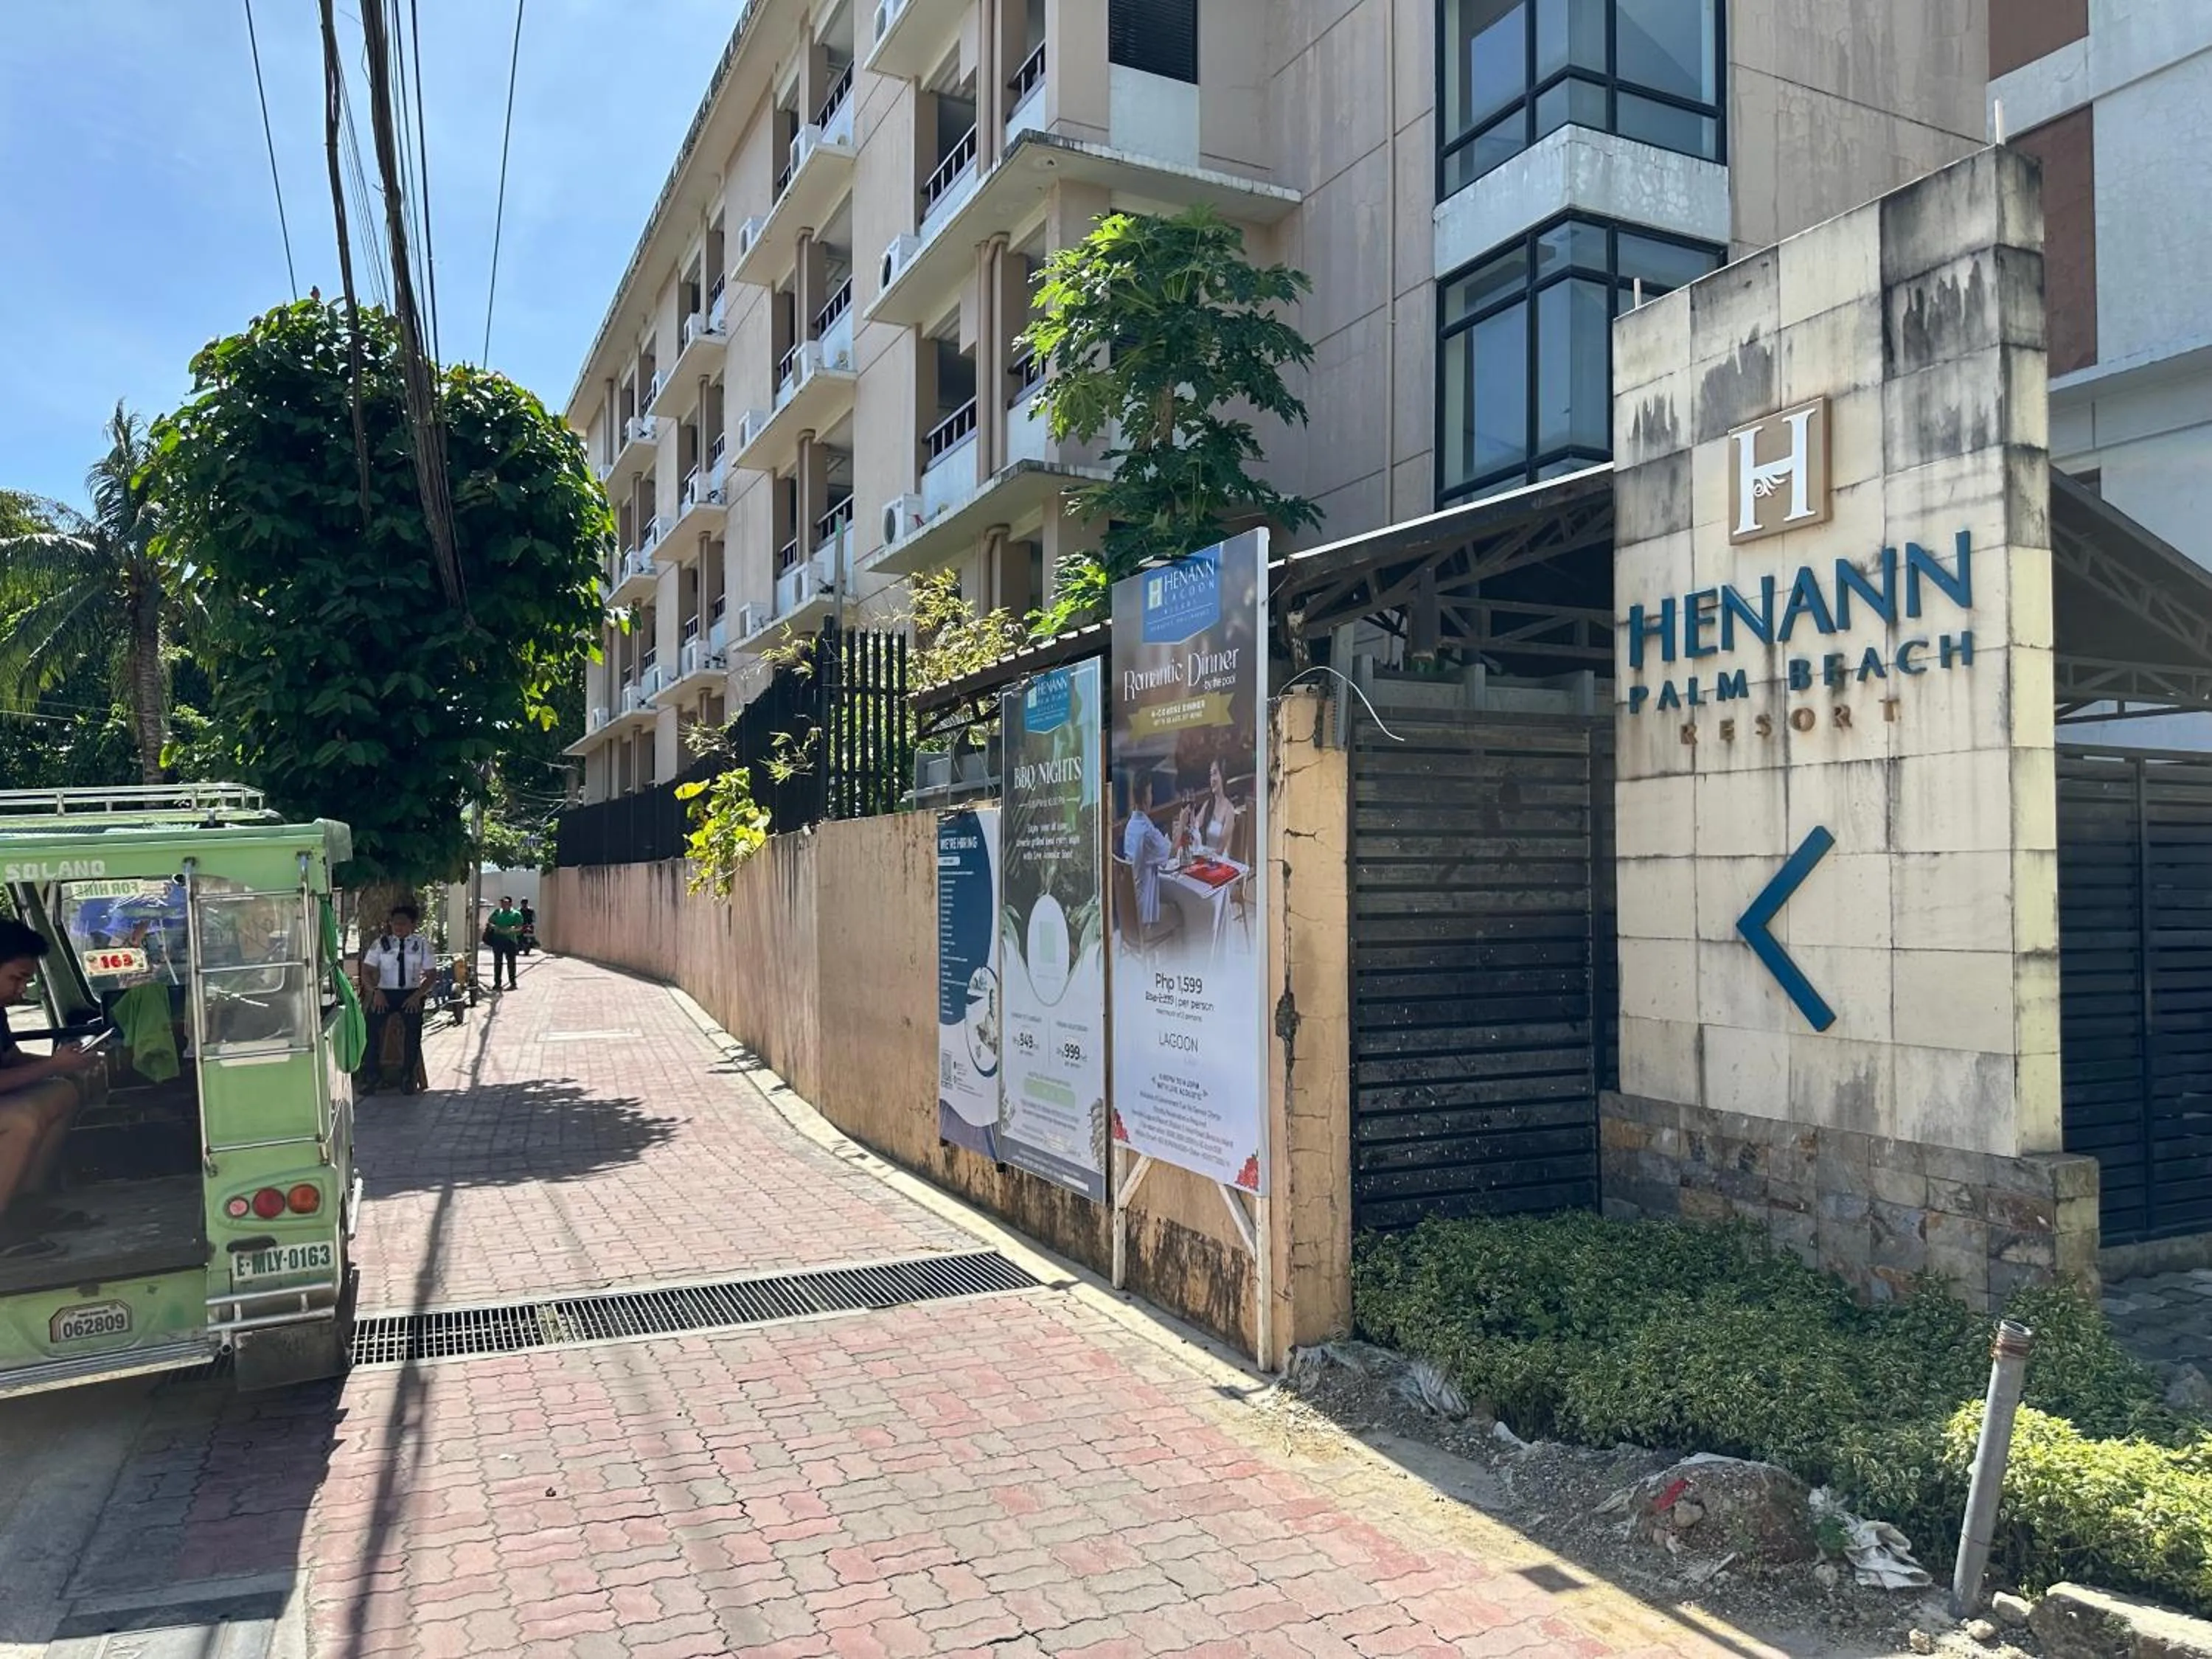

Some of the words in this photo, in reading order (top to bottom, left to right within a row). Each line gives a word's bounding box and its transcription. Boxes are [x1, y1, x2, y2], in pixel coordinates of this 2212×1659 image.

[1732, 408, 1816, 535] H
[1164, 557, 1214, 592] HENANN
[1629, 530, 1972, 669] HENANN
[1124, 658, 1183, 701] Romantic
[1188, 649, 1239, 687] Dinner
[1629, 669, 1750, 714] PALM
[1788, 630, 1973, 691] BEACH
[1681, 699, 1900, 745] RESORT
[1014, 765, 1036, 791] BBQ
[1038, 757, 1082, 784] NIGHTS
[4, 860, 105, 882] SOLANO
[100, 953, 133, 968] 163
[1155, 972, 1175, 993] Php
[1177, 975, 1203, 994] 1,599
[1159, 1032, 1198, 1053] LAGOON
[63, 1312, 125, 1338] 062809
